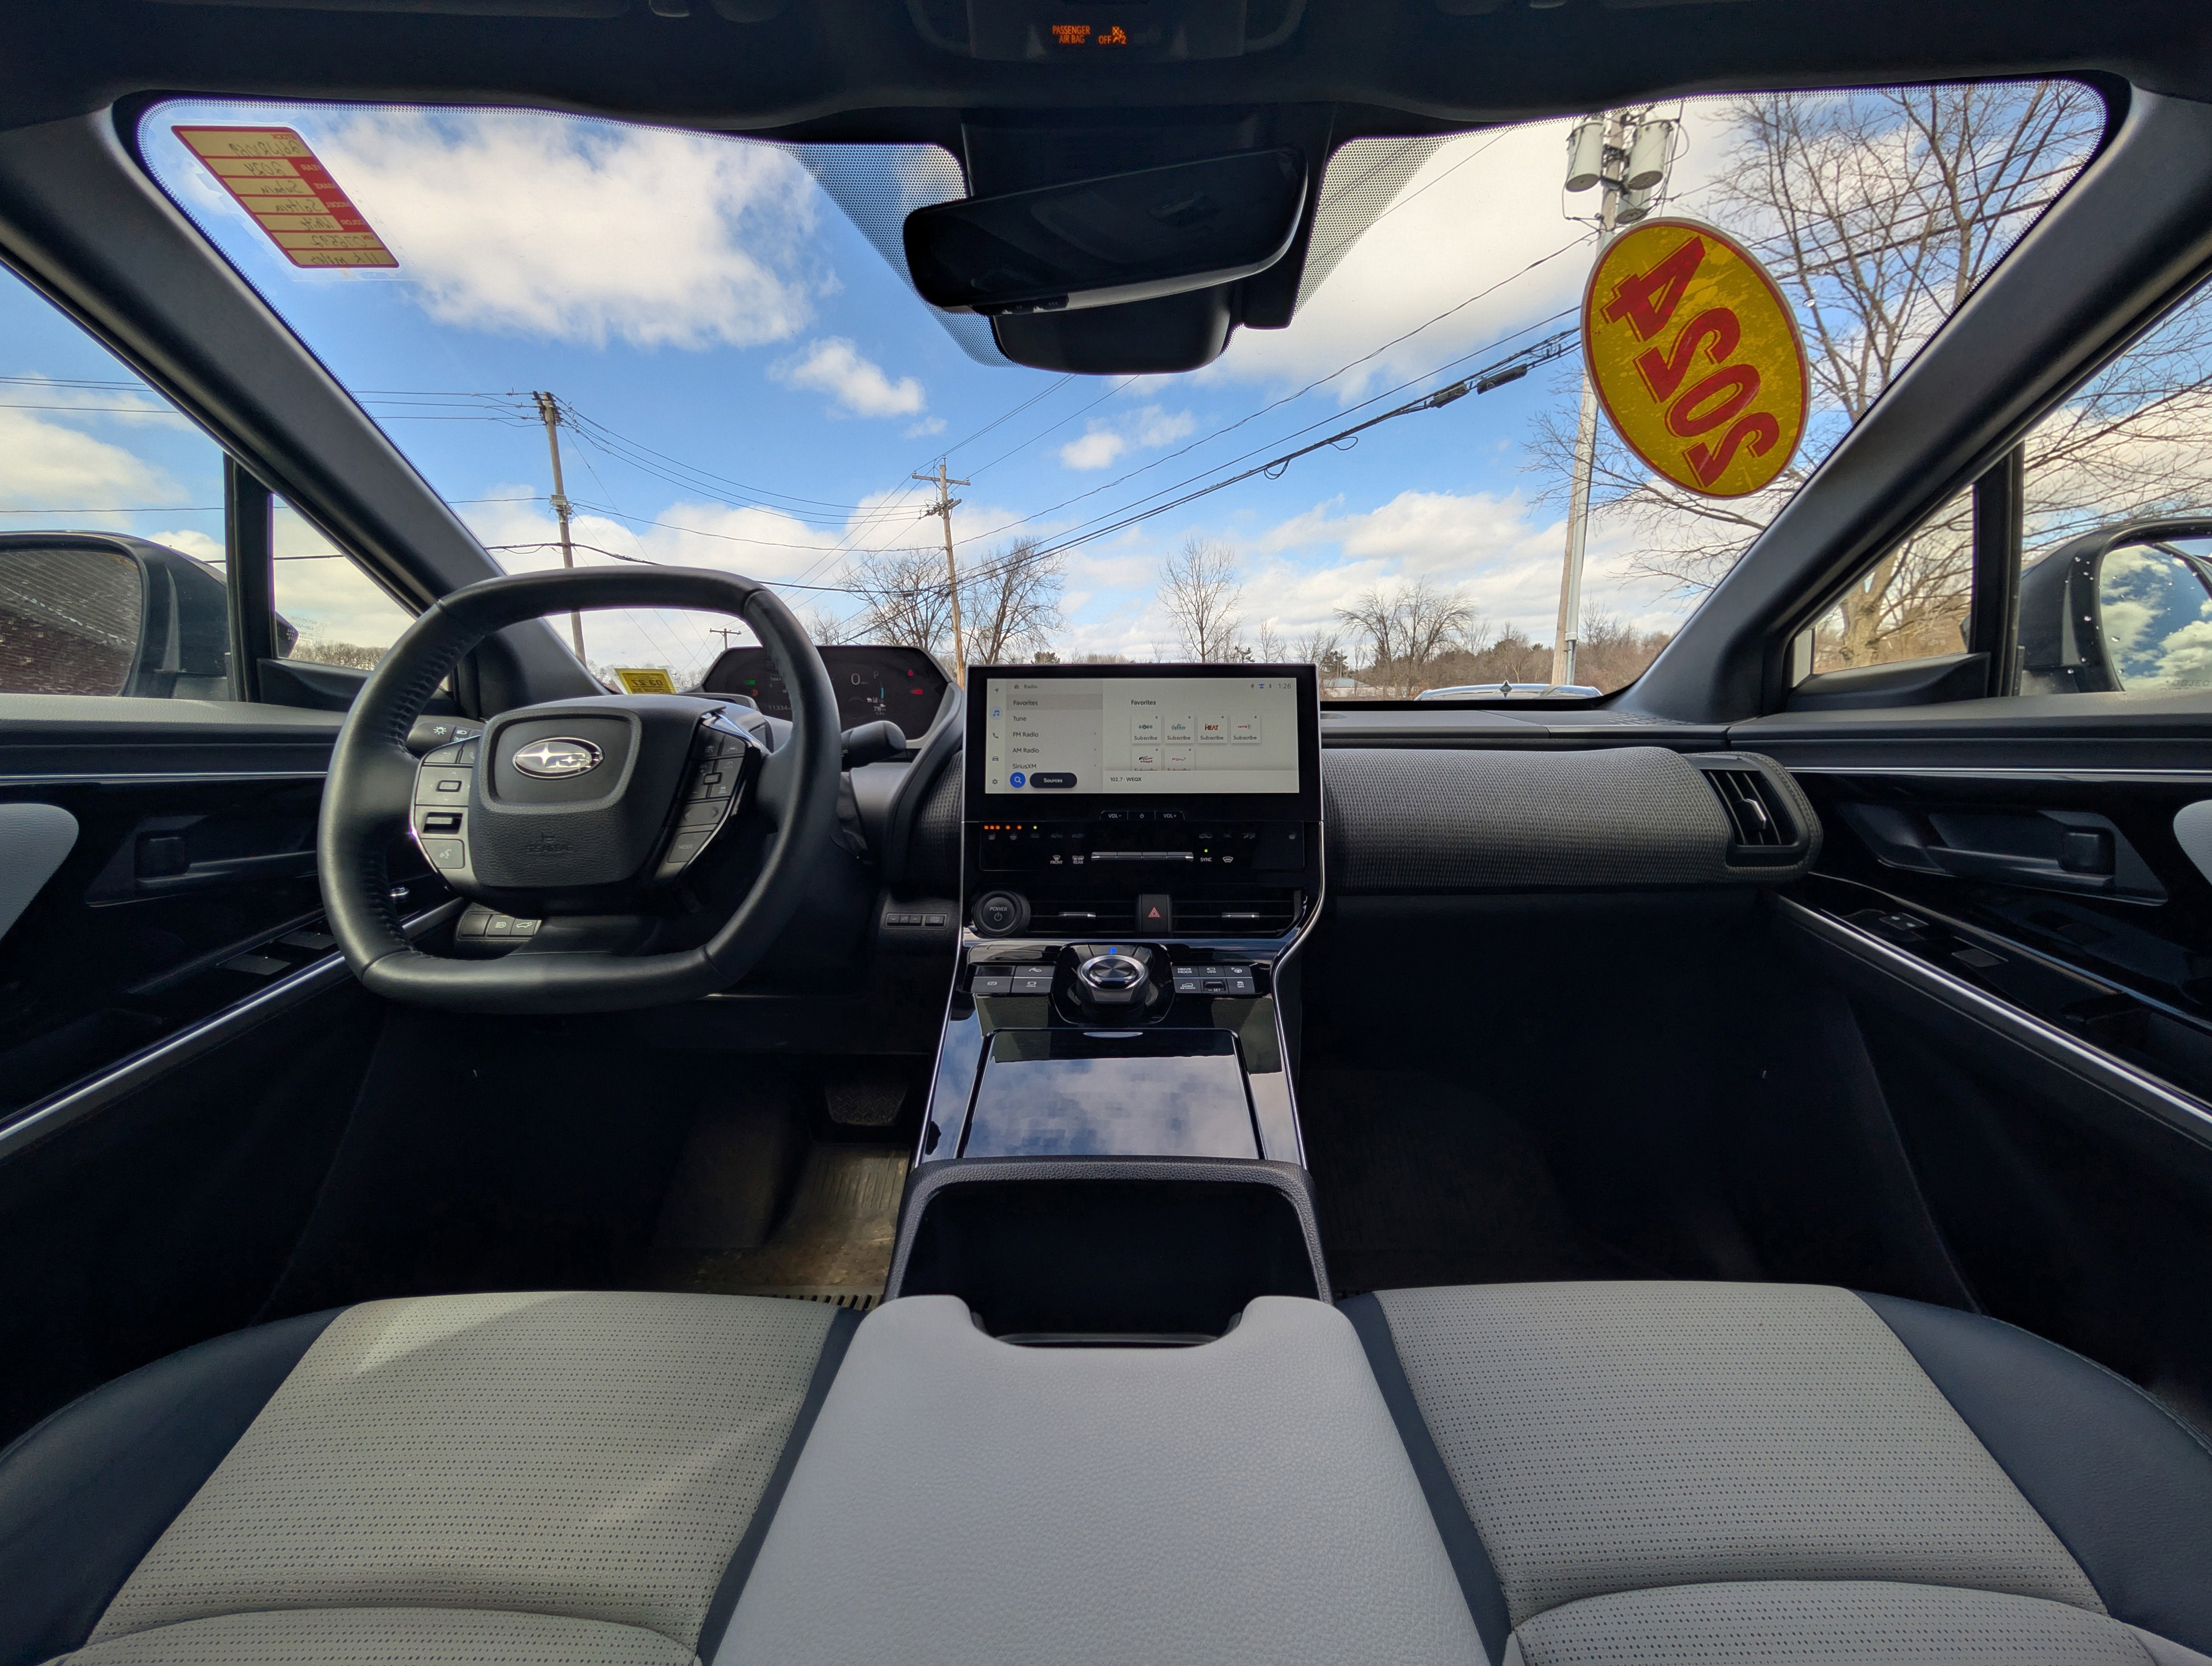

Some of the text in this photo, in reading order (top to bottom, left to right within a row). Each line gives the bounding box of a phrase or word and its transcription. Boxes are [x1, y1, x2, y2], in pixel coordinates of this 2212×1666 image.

[1052, 25, 1090, 34] PASSENGER
[1059, 35, 1085, 44] AIR BAG
[1098, 35, 1111, 44] OFF
